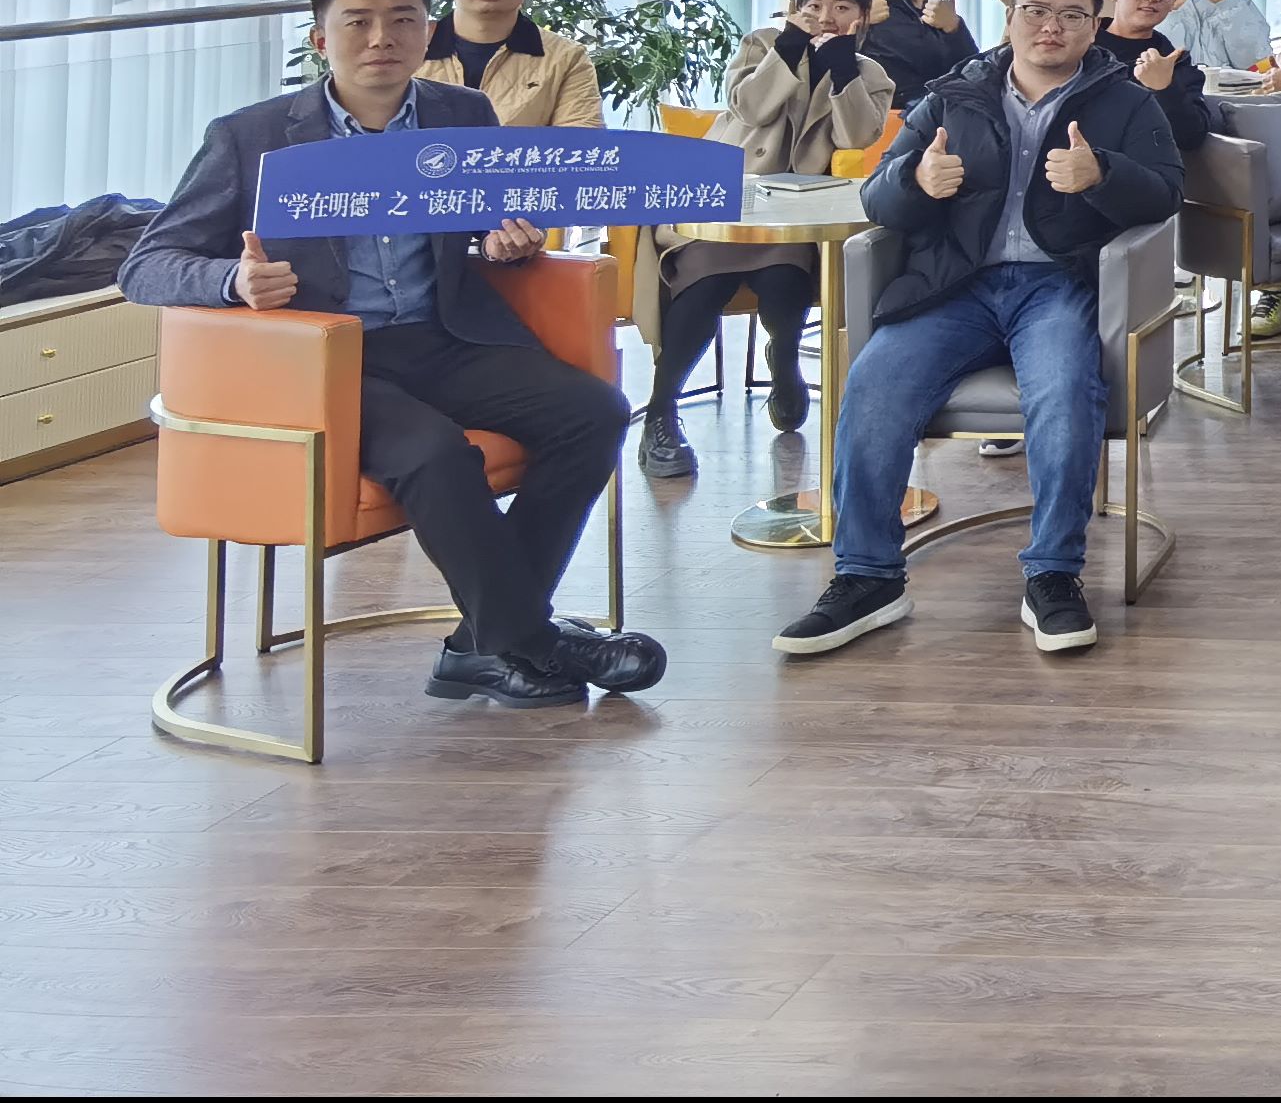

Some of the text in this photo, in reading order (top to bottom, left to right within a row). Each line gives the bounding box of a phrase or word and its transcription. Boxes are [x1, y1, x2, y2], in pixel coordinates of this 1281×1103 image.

[462, 146, 620, 167] 西安明德理工学院
